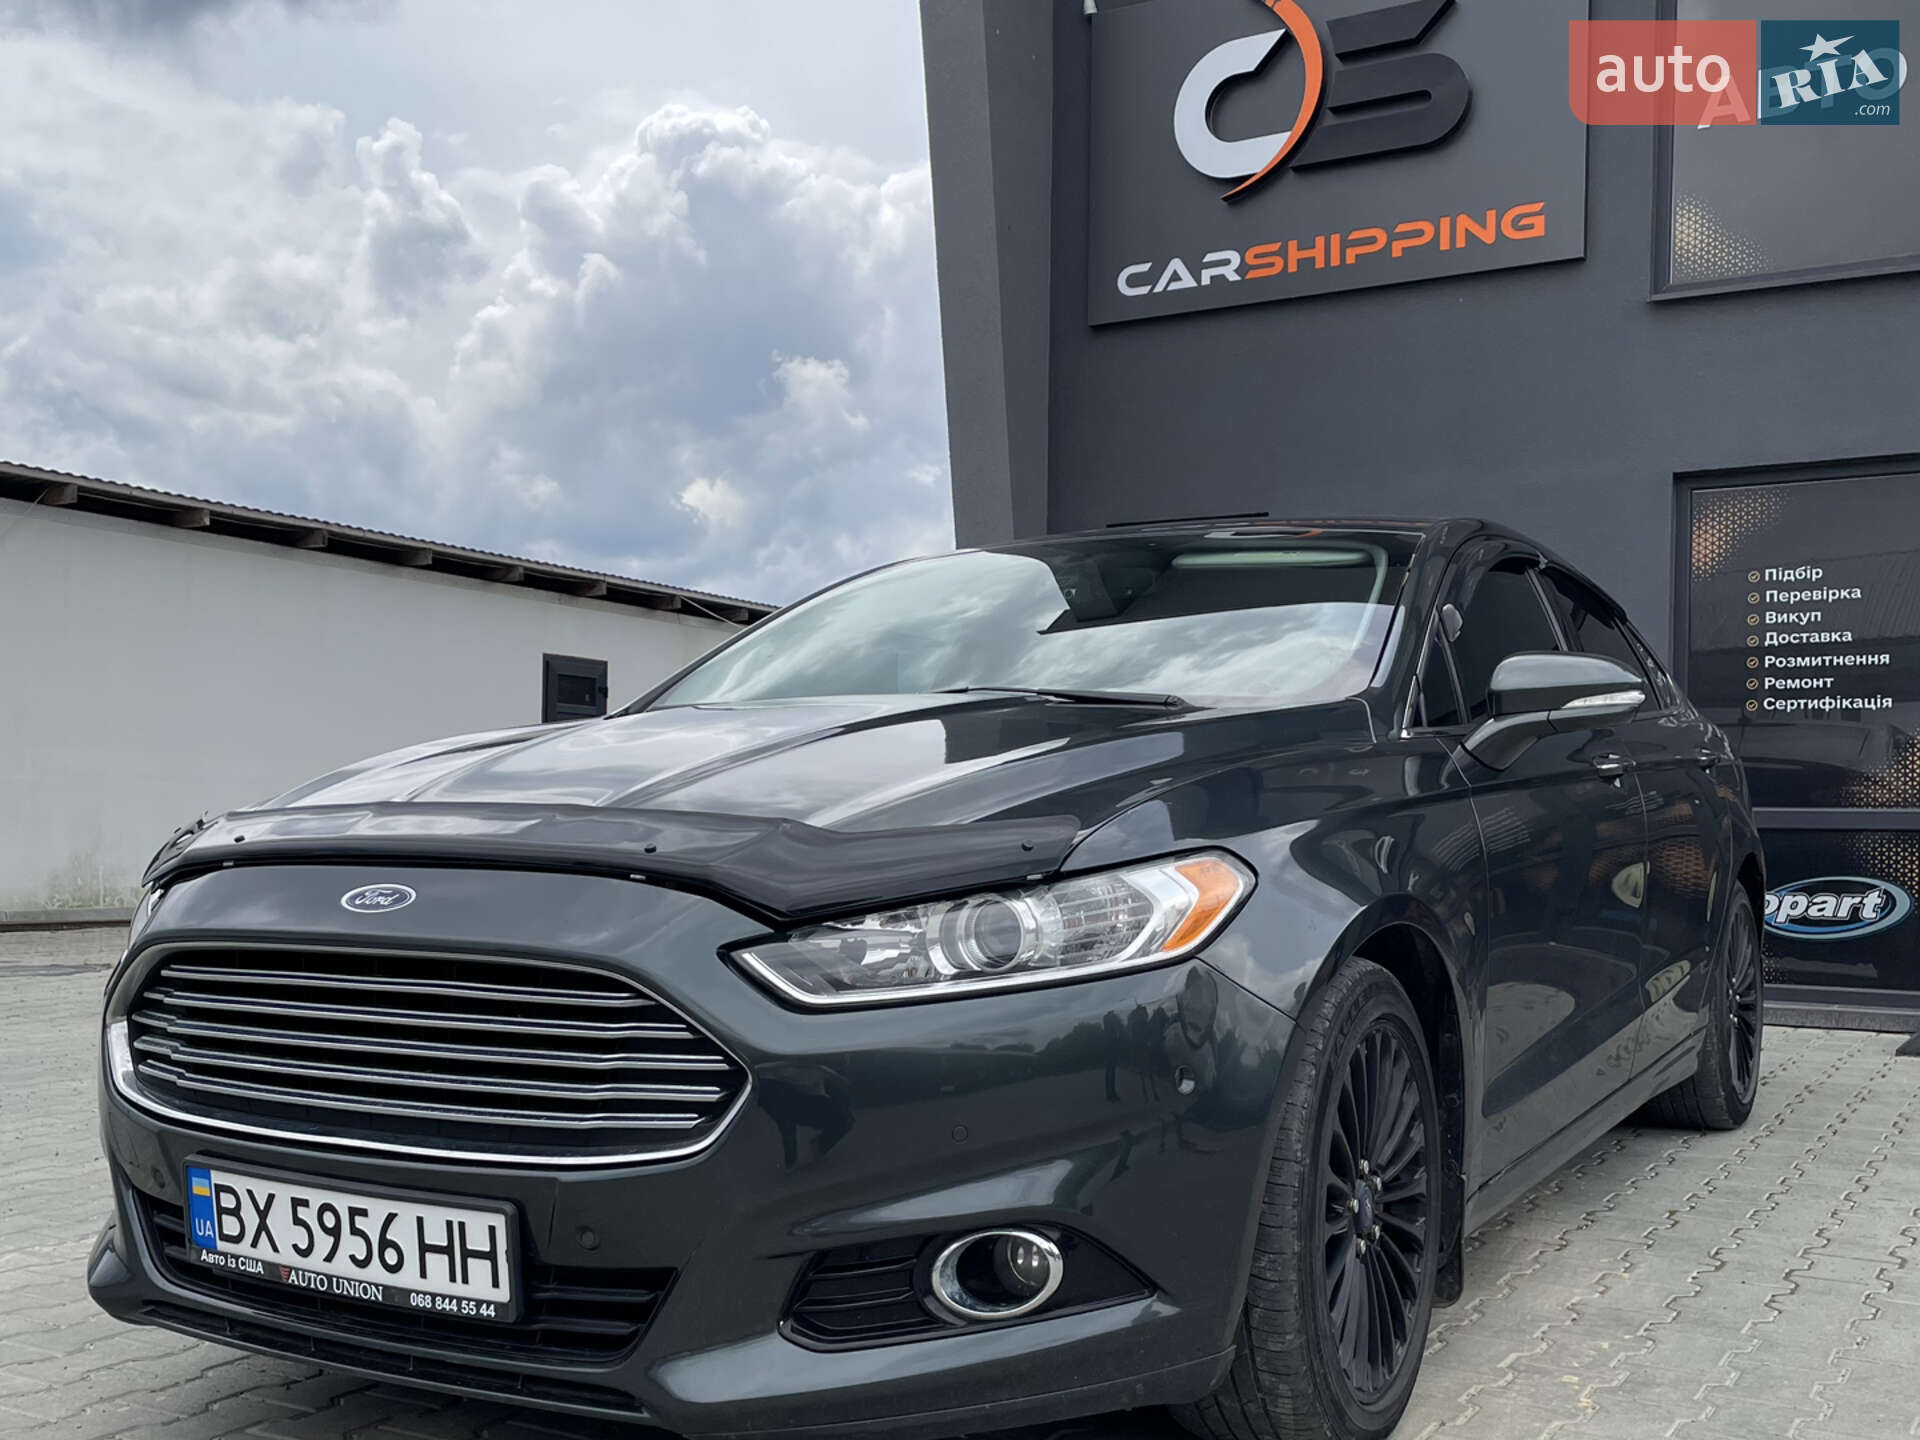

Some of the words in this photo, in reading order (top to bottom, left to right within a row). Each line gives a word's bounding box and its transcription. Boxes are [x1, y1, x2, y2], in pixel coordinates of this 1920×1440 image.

[1116, 201, 1546, 297] CARSHIPPING
[1764, 566, 1824, 583] Підбір
[1765, 587, 1862, 604] Перевірка
[1765, 611, 1822, 625] Викуп
[1764, 630, 1853, 647] Доставка
[1764, 653, 1891, 668] Розмитнення
[1764, 676, 1835, 689] Ремонт
[1763, 695, 1893, 712] Сертифікація
[355, 888, 400, 906] Ford
[1764, 888, 1884, 924] opart
[195, 1218, 215, 1239] UA
[200, 1249, 225, 1266] Авто
[238, 1257, 265, 1275] США
[288, 1269, 328, 1291] AUTO
[332, 1277, 384, 1301] UNION
[410, 1292, 432, 1308] 068
[435, 1296, 458, 1312] 844
[461, 1301, 477, 1315] 55
[480, 1303, 496, 1318] 44
